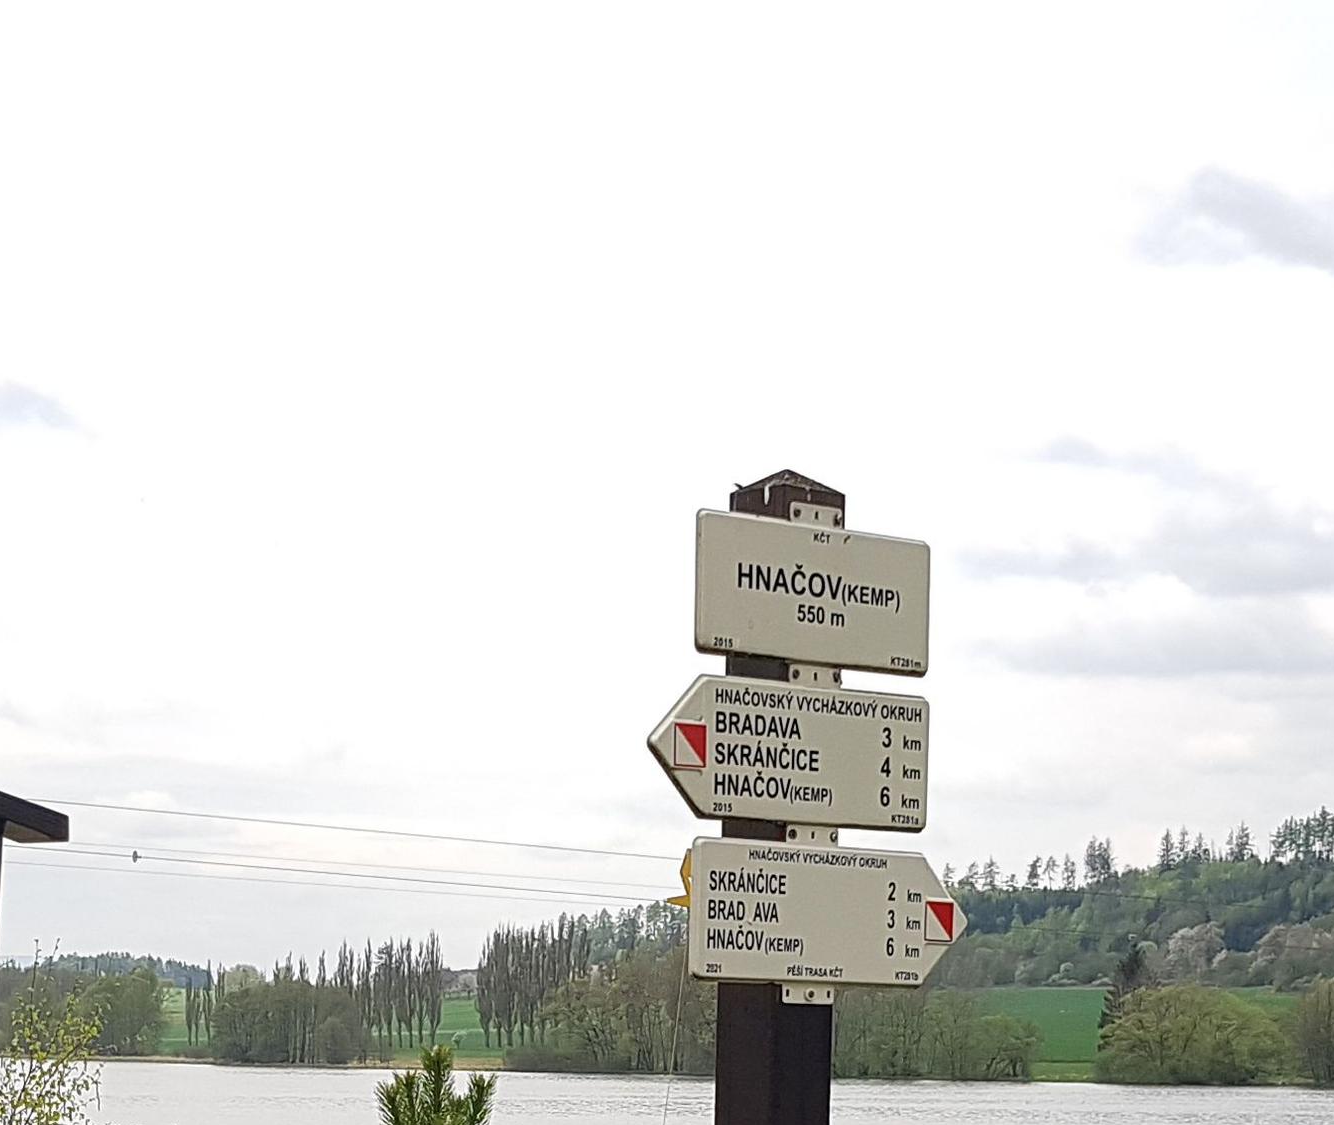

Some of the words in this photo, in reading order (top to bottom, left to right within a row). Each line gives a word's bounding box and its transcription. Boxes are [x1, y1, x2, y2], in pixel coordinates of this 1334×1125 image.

[813, 532, 831, 544] KČT
[797, 604, 825, 625] 550
[830, 612, 845, 627] m
[713, 637, 733, 648] 2015
[715, 687, 793, 708] HNAČOVSKÝ
[797, 696, 876, 718] VYCHÁZKOVÝ
[881, 705, 922, 722] OKRUH
[715, 711, 801, 739] BRADAVA
[882, 727, 892, 748] 3
[903, 736, 921, 751] km
[715, 742, 819, 771] SKRÁNČICE
[902, 765, 921, 780] km
[713, 802, 732, 812] 2015
[880, 786, 890, 807] 6
[902, 794, 920, 809] km
[749, 848, 801, 863] HNAČOVSKÝ
[802, 851, 857, 867] VYCHÁZKOVÝ
[859, 858, 887, 869] OKRUH
[709, 867, 786, 894] SKRÁNČICE
[888, 882, 896, 901] 2
[907, 888, 921, 903] km
[887, 909, 895, 929] 3
[906, 916, 920, 930] km
[886, 938, 894, 957] 6
[905, 944, 919, 958] km
[805, 966, 827, 978] TRASA
[829, 967, 843, 979] KČT
